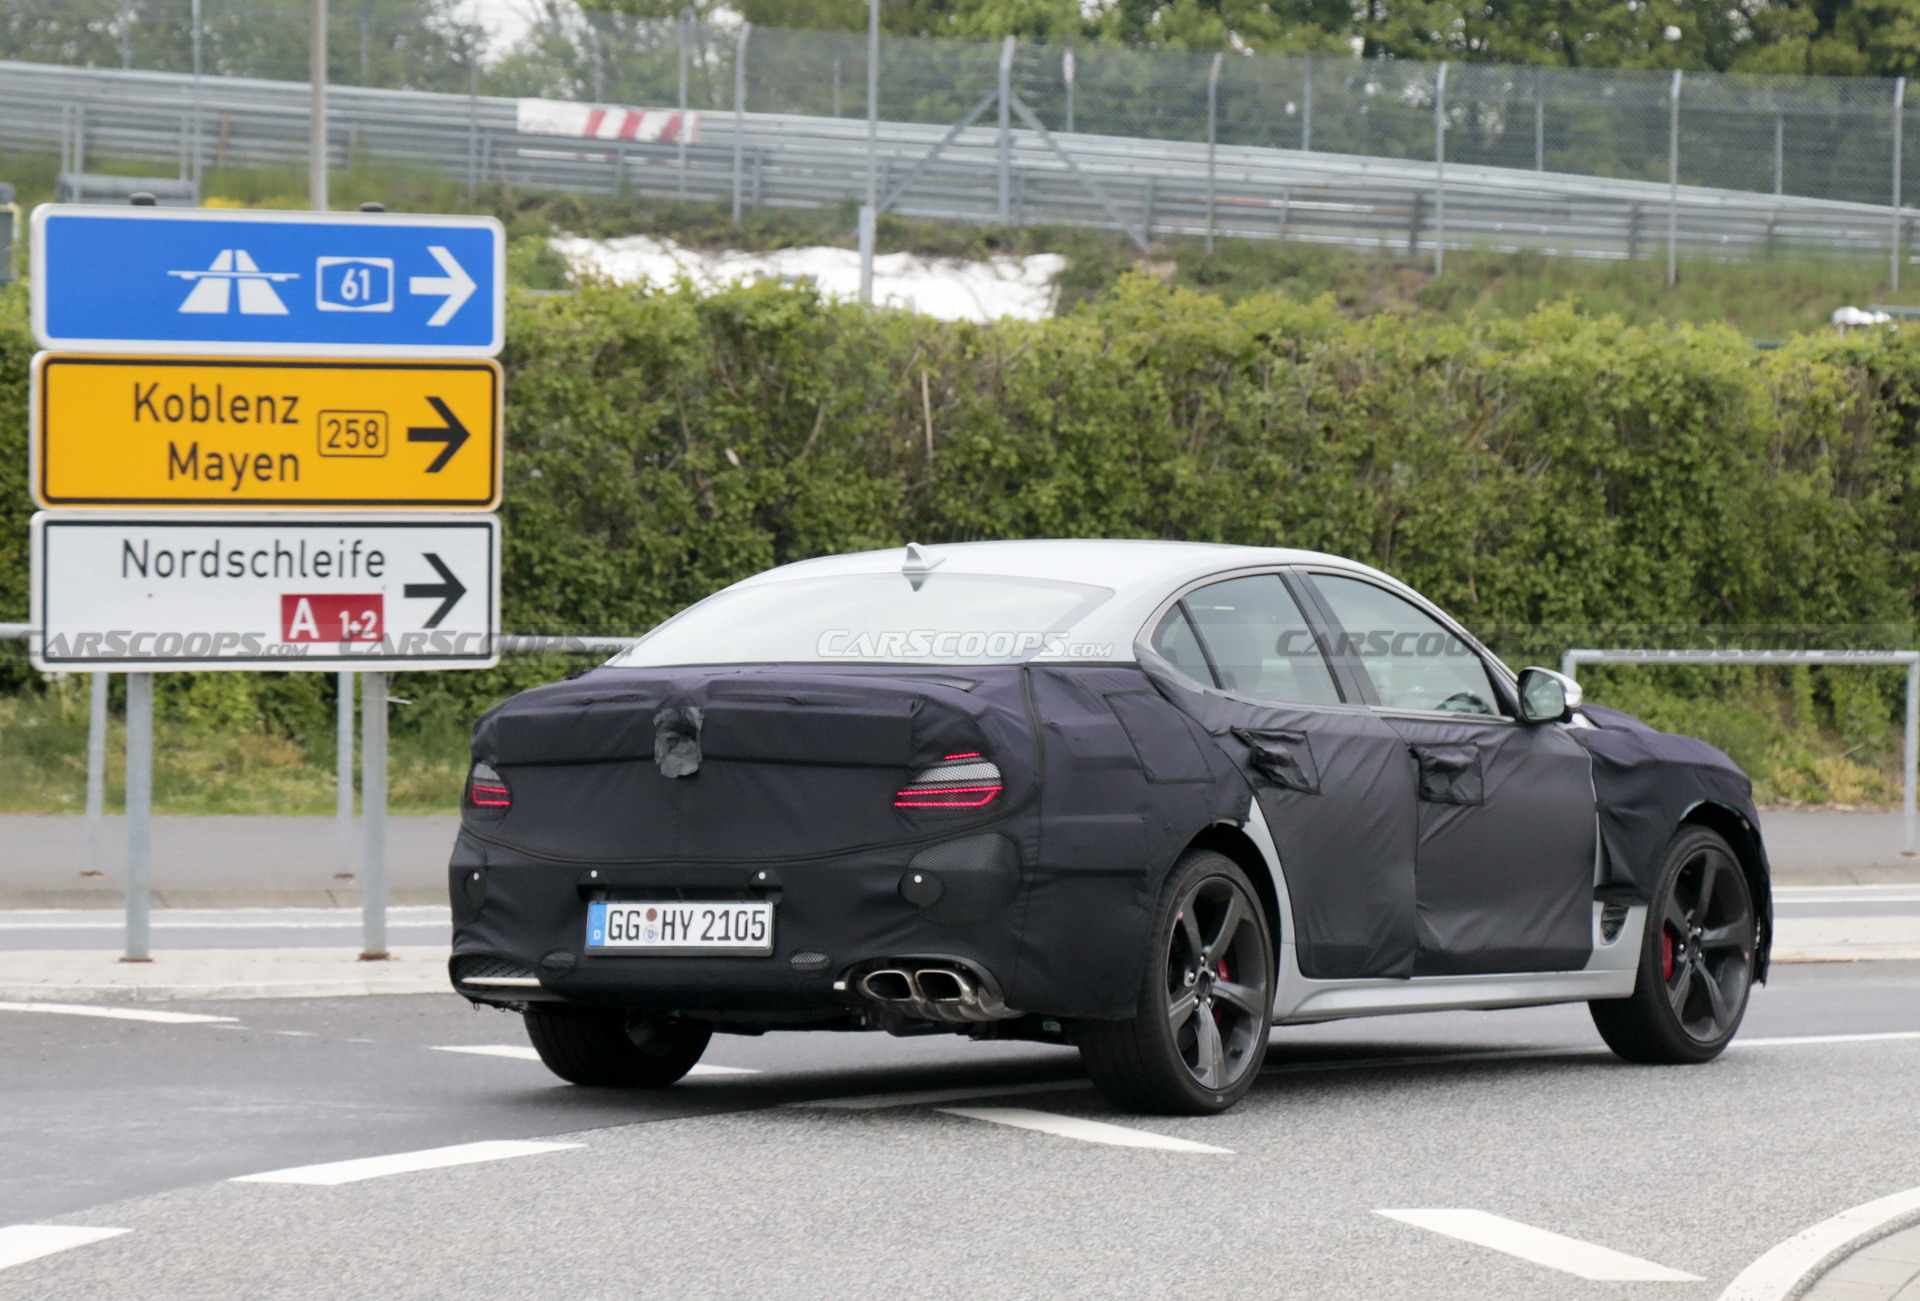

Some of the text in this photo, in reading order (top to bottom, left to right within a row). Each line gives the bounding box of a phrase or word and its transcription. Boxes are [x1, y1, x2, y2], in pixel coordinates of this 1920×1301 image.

[340, 268, 370, 301] 61
[133, 382, 300, 425] Koblenz
[326, 418, 380, 450] 258
[168, 440, 301, 493] Mayen
[121, 538, 386, 579] Nordschleife
[288, 597, 320, 640] A
[593, 910, 766, 941] D GG HY 2105
